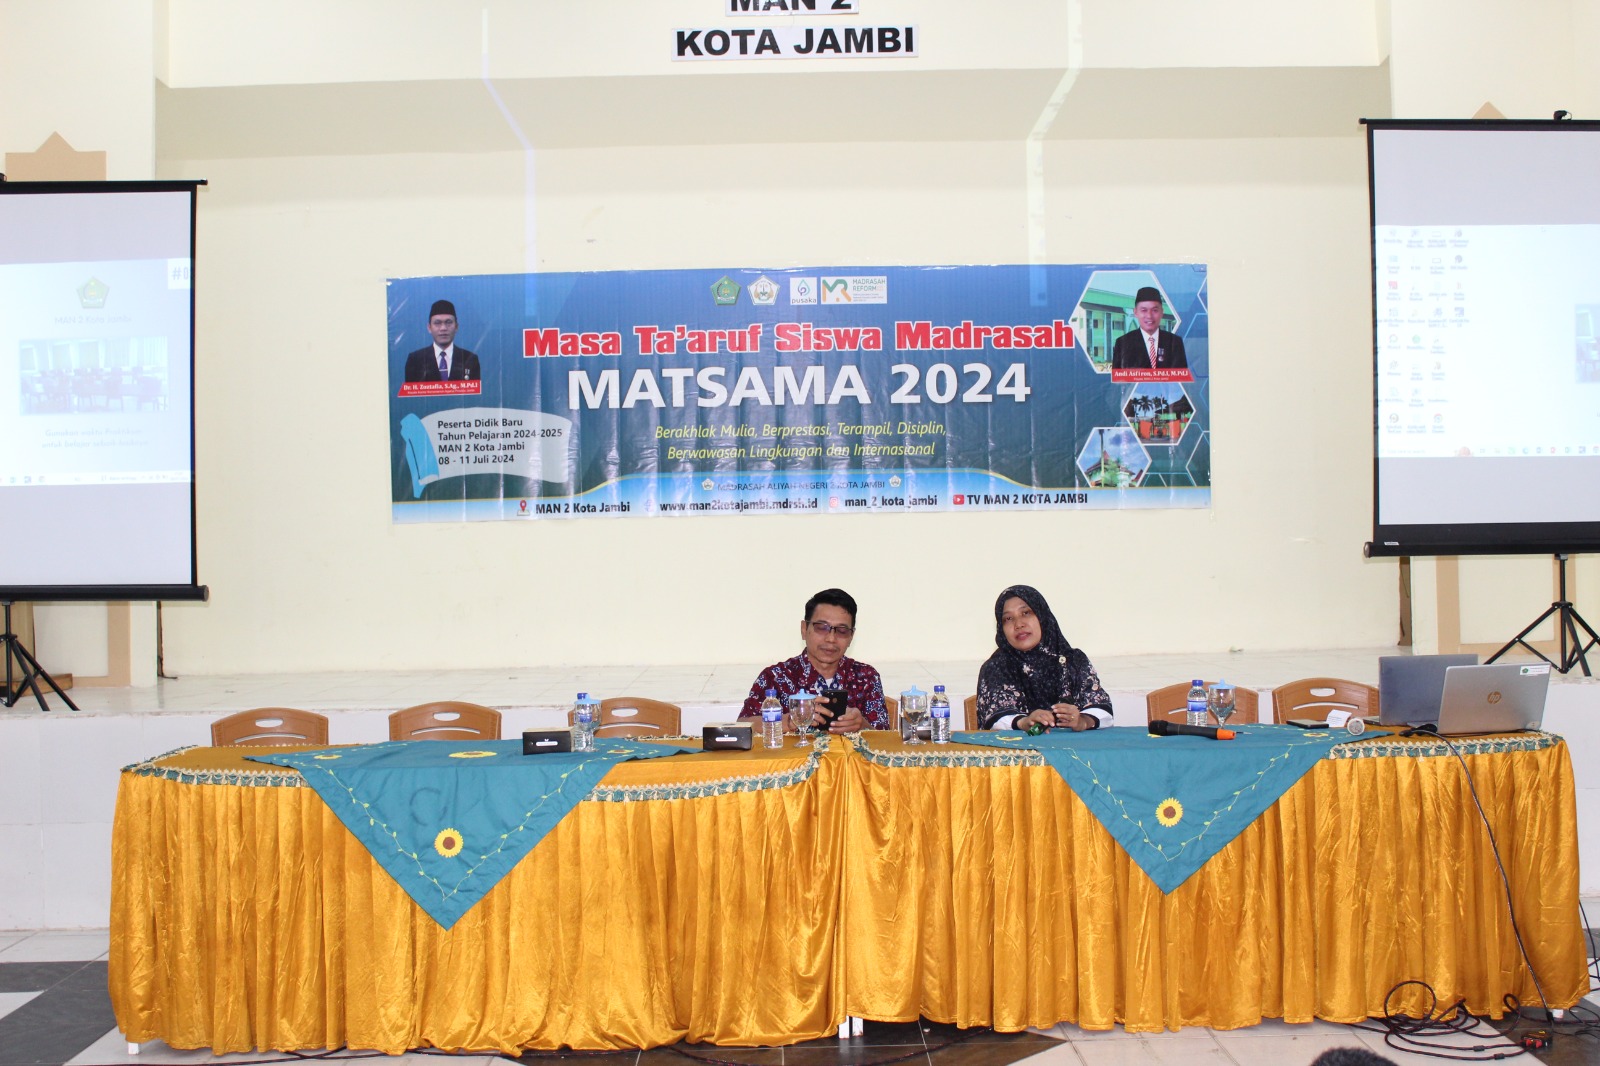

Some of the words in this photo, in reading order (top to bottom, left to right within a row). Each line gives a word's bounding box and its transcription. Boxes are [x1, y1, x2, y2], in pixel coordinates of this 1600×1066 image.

[676, 29, 781, 56] KOTA
[794, 27, 914, 54] JAMBI
[523, 327, 622, 358] Masa
[633, 323, 763, 356] Ta'aruf
[775, 322, 882, 352] Siswa
[895, 320, 1075, 351] Madrasah
[568, 366, 872, 410] MATSAMA
[890, 362, 1031, 404] 2024
[437, 420, 472, 429] Peserta
[474, 418, 499, 428] Didik
[502, 418, 523, 427] Baru
[655, 424, 716, 439] Berakhlak
[720, 424, 758, 439] Mulia,
[762, 422, 833, 440] Berprestasi,
[837, 421, 893, 438] Terampil,
[897, 420, 947, 438] Disiplin,
[438, 431, 466, 441] Tahun
[468, 430, 511, 441] Pelajaran
[513, 428, 563, 439] 2024-2025
[438, 443, 462, 453] MAN
[464, 443, 471, 452] 2
[473, 442, 495, 452] Kota
[497, 441, 525, 451] Jambi
[667, 446, 746, 460] Berwawasan
[749, 444, 822, 461] Lingkungan
[826, 443, 850, 457] dan
[853, 441, 935, 456] Internasional
[438, 456, 450, 465] 08
[460, 456, 470, 465] 11
[473, 454, 489, 464] Juli
[492, 454, 515, 464] 2024
[717, 483, 765, 491] MADRASAH
[767, 482, 797, 491] ALIYAH
[799, 481, 828, 490] NEGERI
[837, 481, 859, 489] KOTA
[860, 480, 885, 489] JAMBI
[845, 494, 938, 508] man_2_kota_jambi
[967, 494, 981, 505] TV
[984, 494, 1010, 505] MAN
[1013, 494, 1019, 504] 2
[1022, 493, 1051, 504] KOTA
[1054, 493, 1088, 504] JAMBI
[535, 503, 561, 514] MAN
[564, 502, 570, 513] 2
[573, 501, 597, 513] Kota
[599, 501, 631, 512] Jambi
